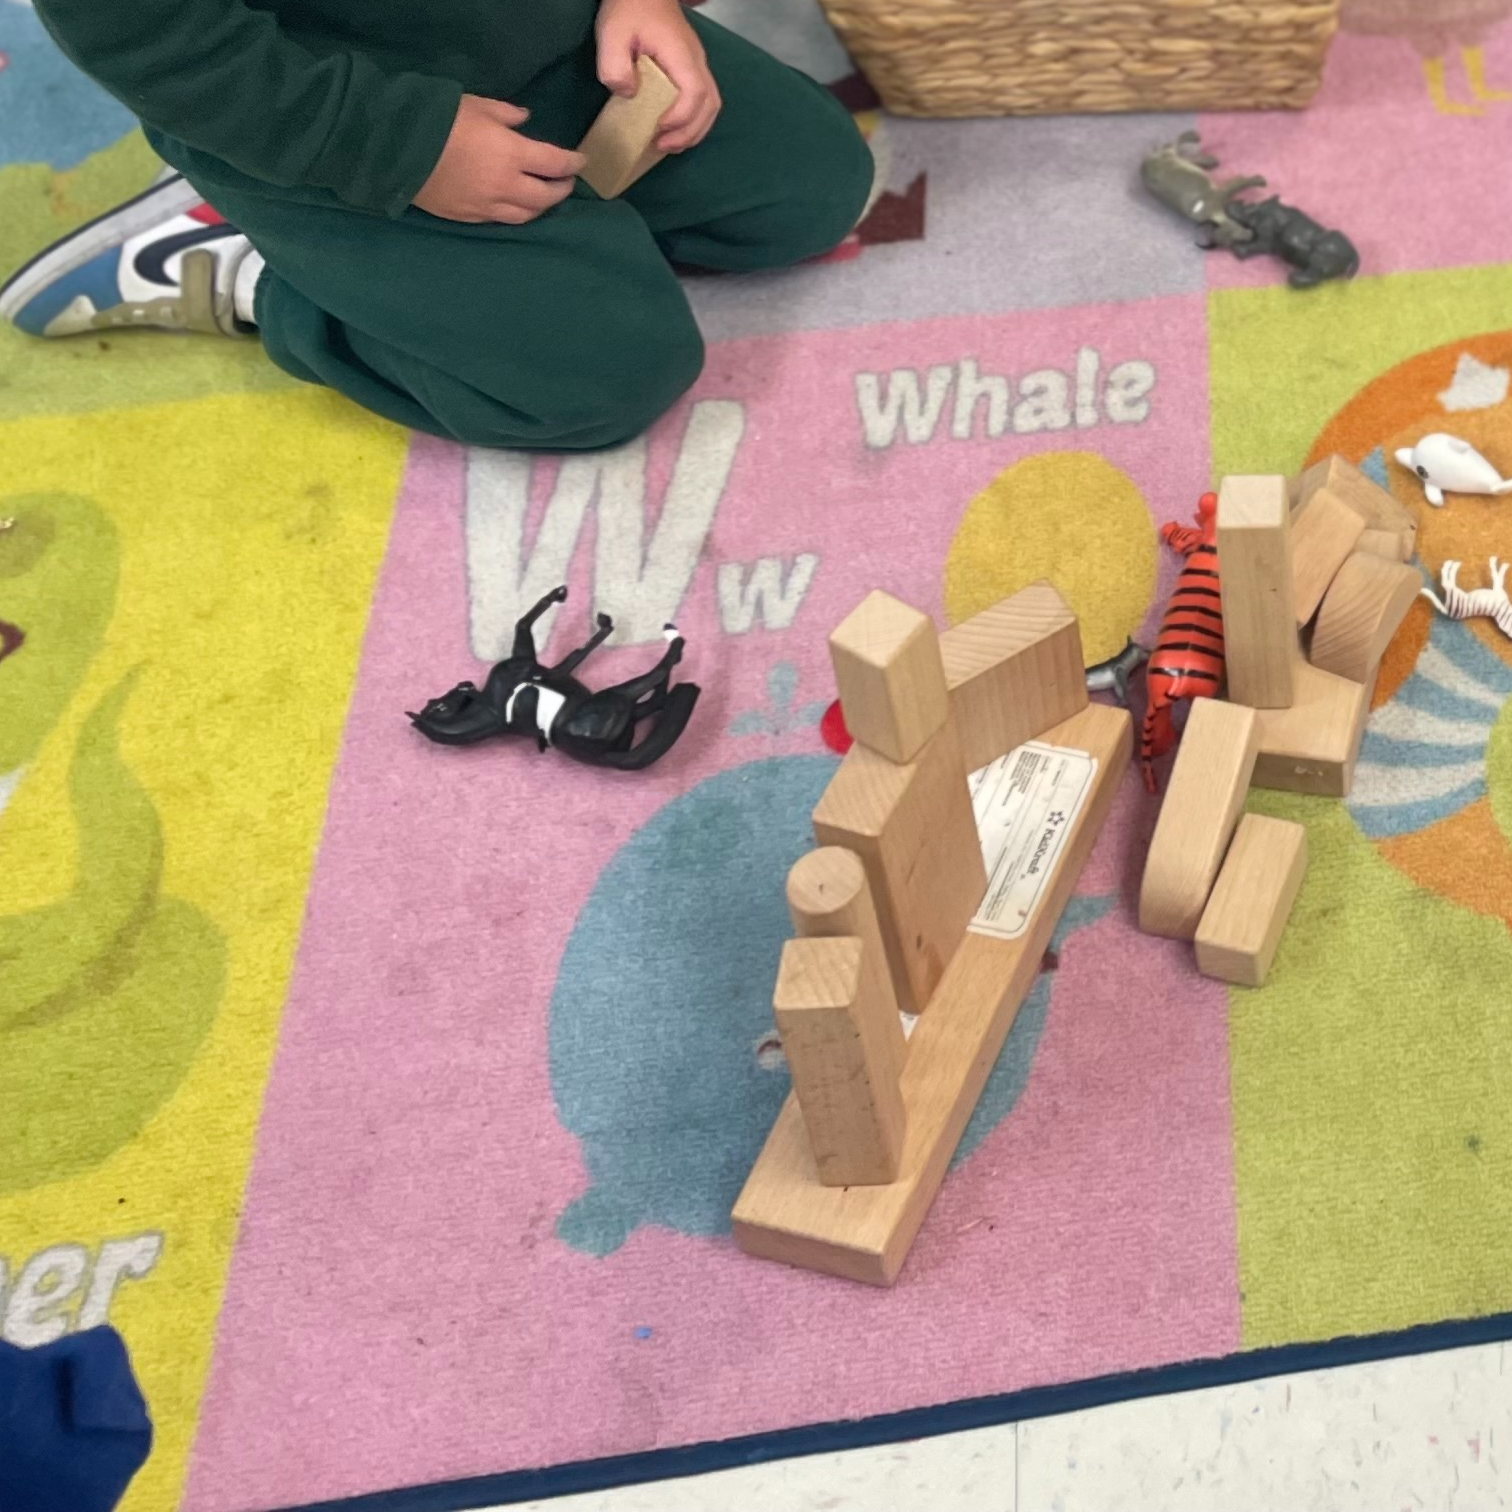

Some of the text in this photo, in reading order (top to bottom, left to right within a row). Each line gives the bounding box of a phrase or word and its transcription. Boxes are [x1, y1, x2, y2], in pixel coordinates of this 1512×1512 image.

[854, 346, 1157, 449] Whale
[465, 399, 818, 662] W w
[0, 1233, 163, 1352] er
